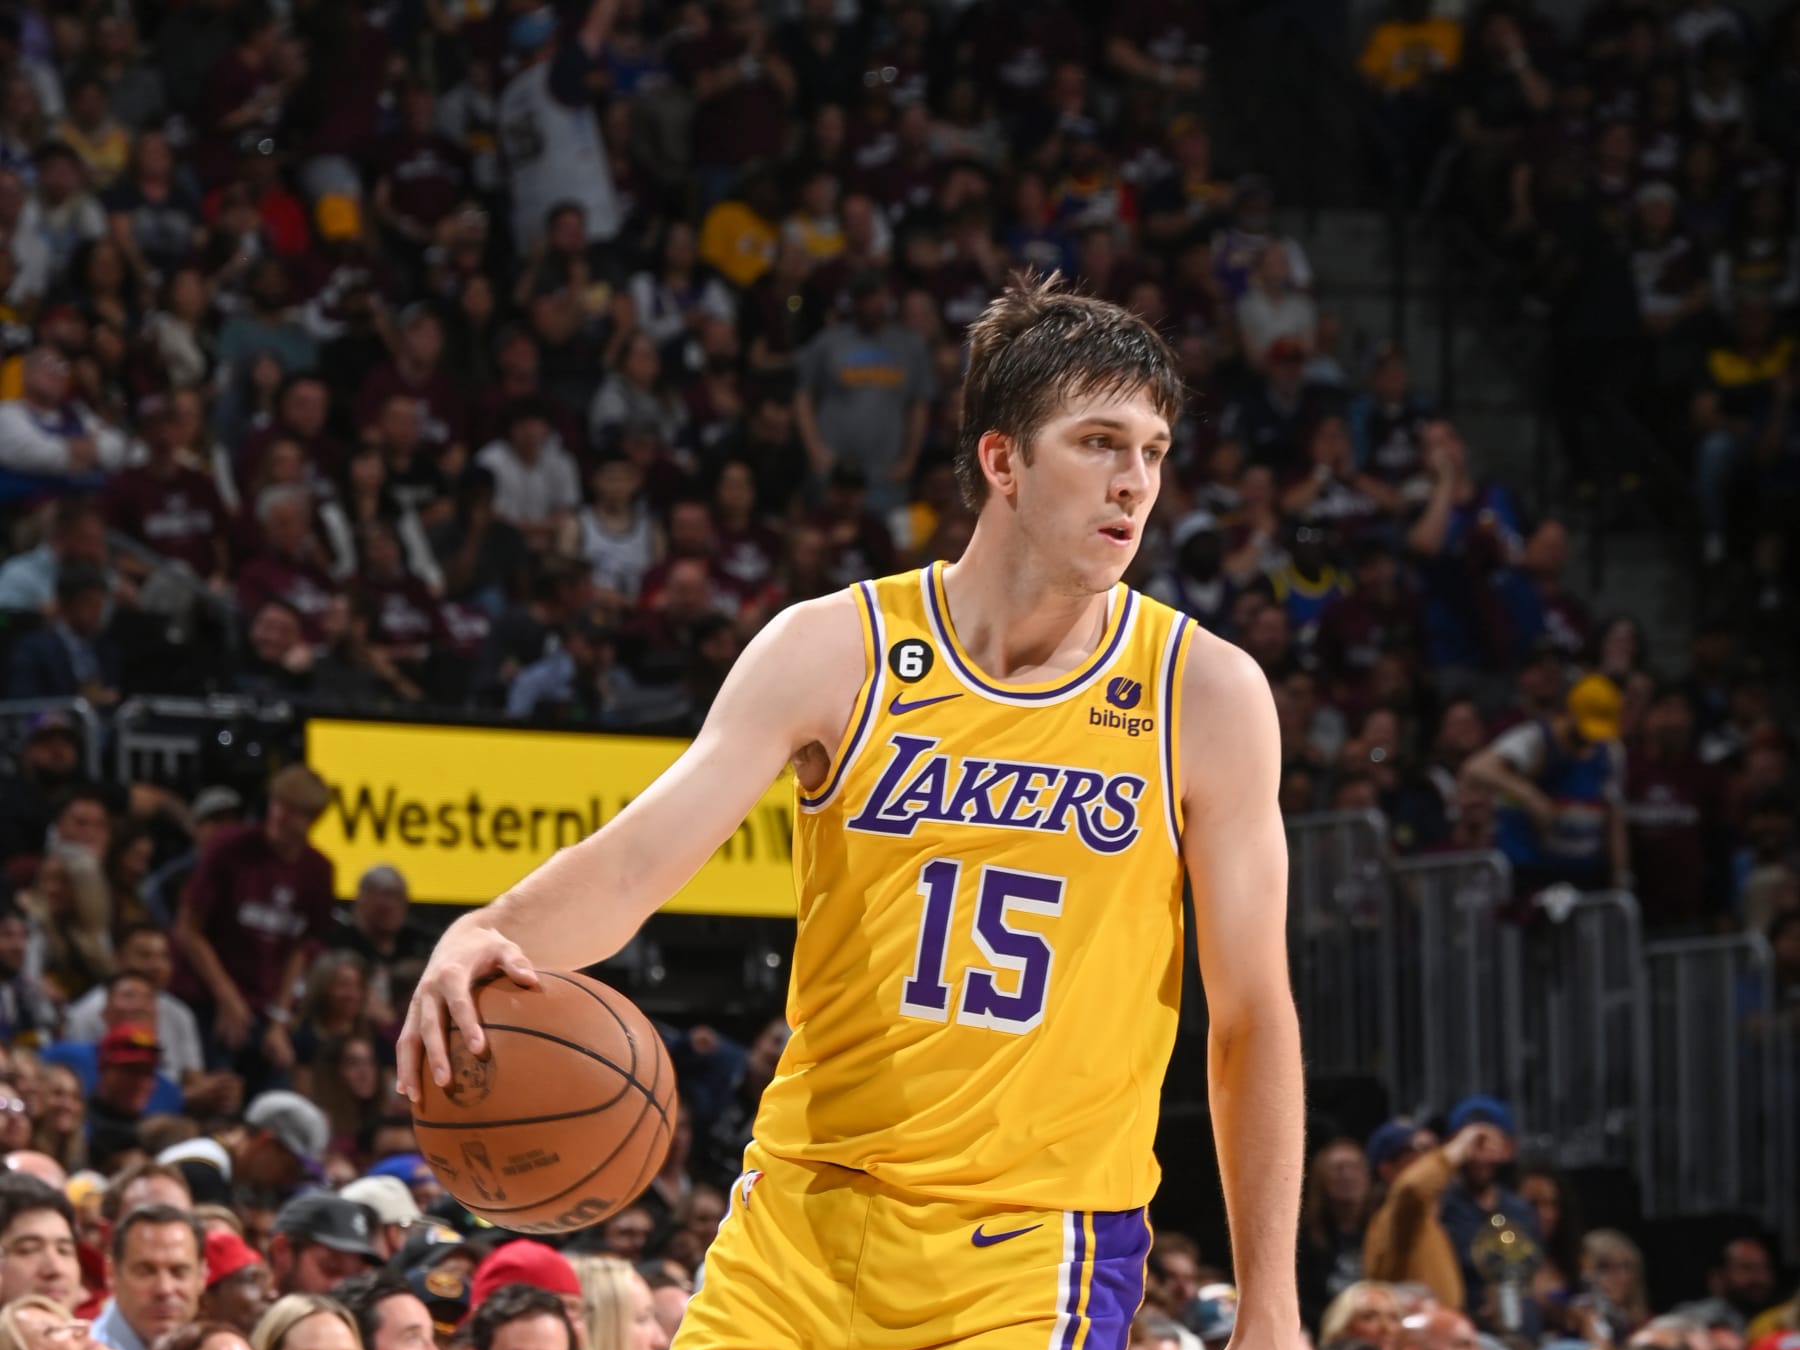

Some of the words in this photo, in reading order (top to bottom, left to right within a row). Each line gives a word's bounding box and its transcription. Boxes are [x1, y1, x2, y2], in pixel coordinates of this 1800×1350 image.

[899, 645, 925, 678] 6
[1089, 707, 1154, 737] bibigo
[844, 731, 1148, 855] LAKERS
[899, 856, 1068, 1035] 15
